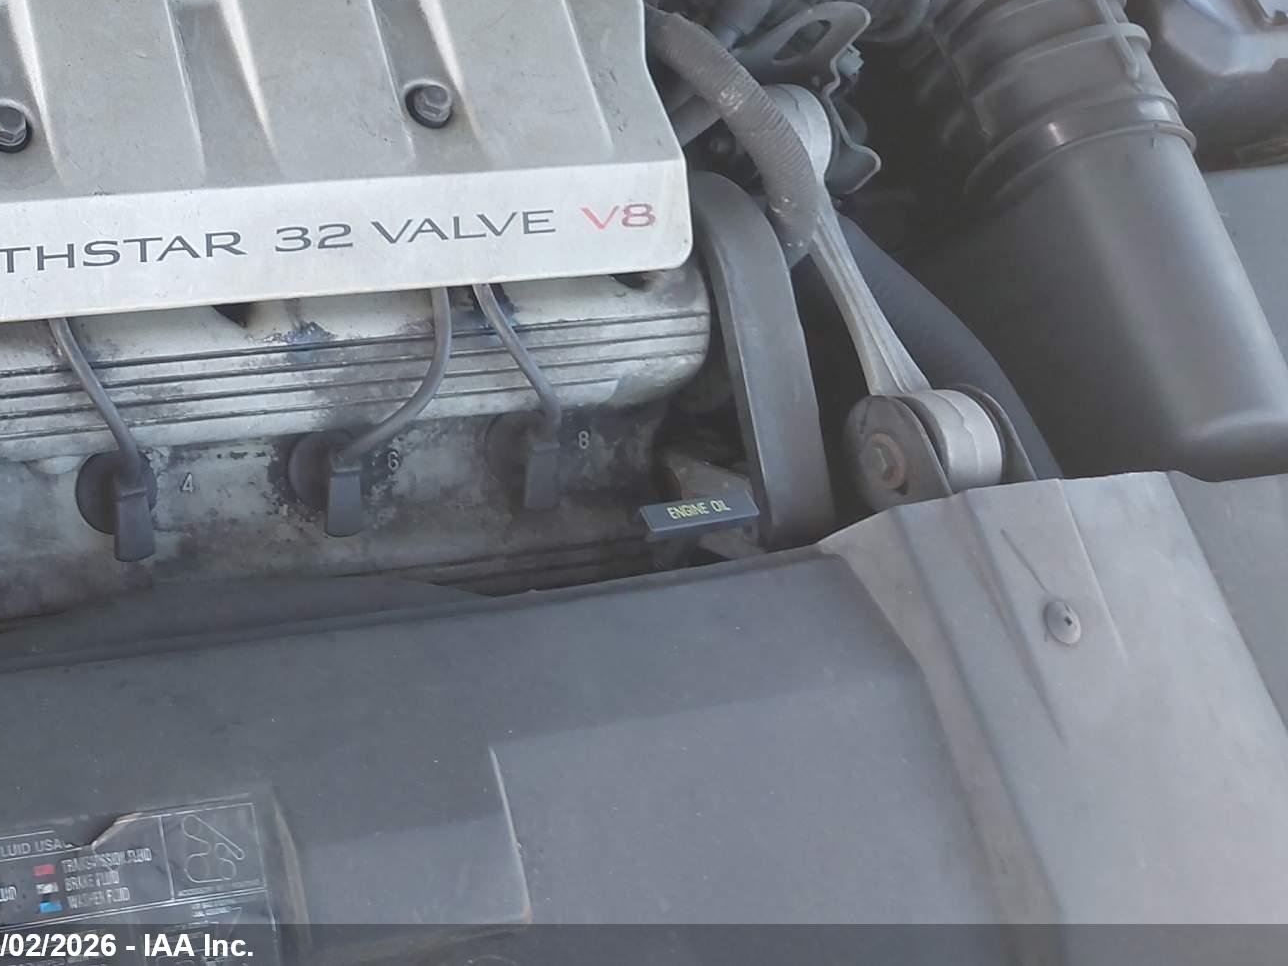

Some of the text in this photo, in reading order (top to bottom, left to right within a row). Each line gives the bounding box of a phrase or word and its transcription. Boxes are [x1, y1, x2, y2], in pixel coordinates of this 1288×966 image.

[274, 223, 354, 252] 32
[370, 209, 557, 244] VALVE
[580, 203, 656, 230] V8
[578, 431, 590, 450] 8
[387, 450, 400, 471] 6
[180, 472, 195, 493] 4
[666, 500, 733, 519] ENGINE OIL
[35, 838, 73, 852] USA
